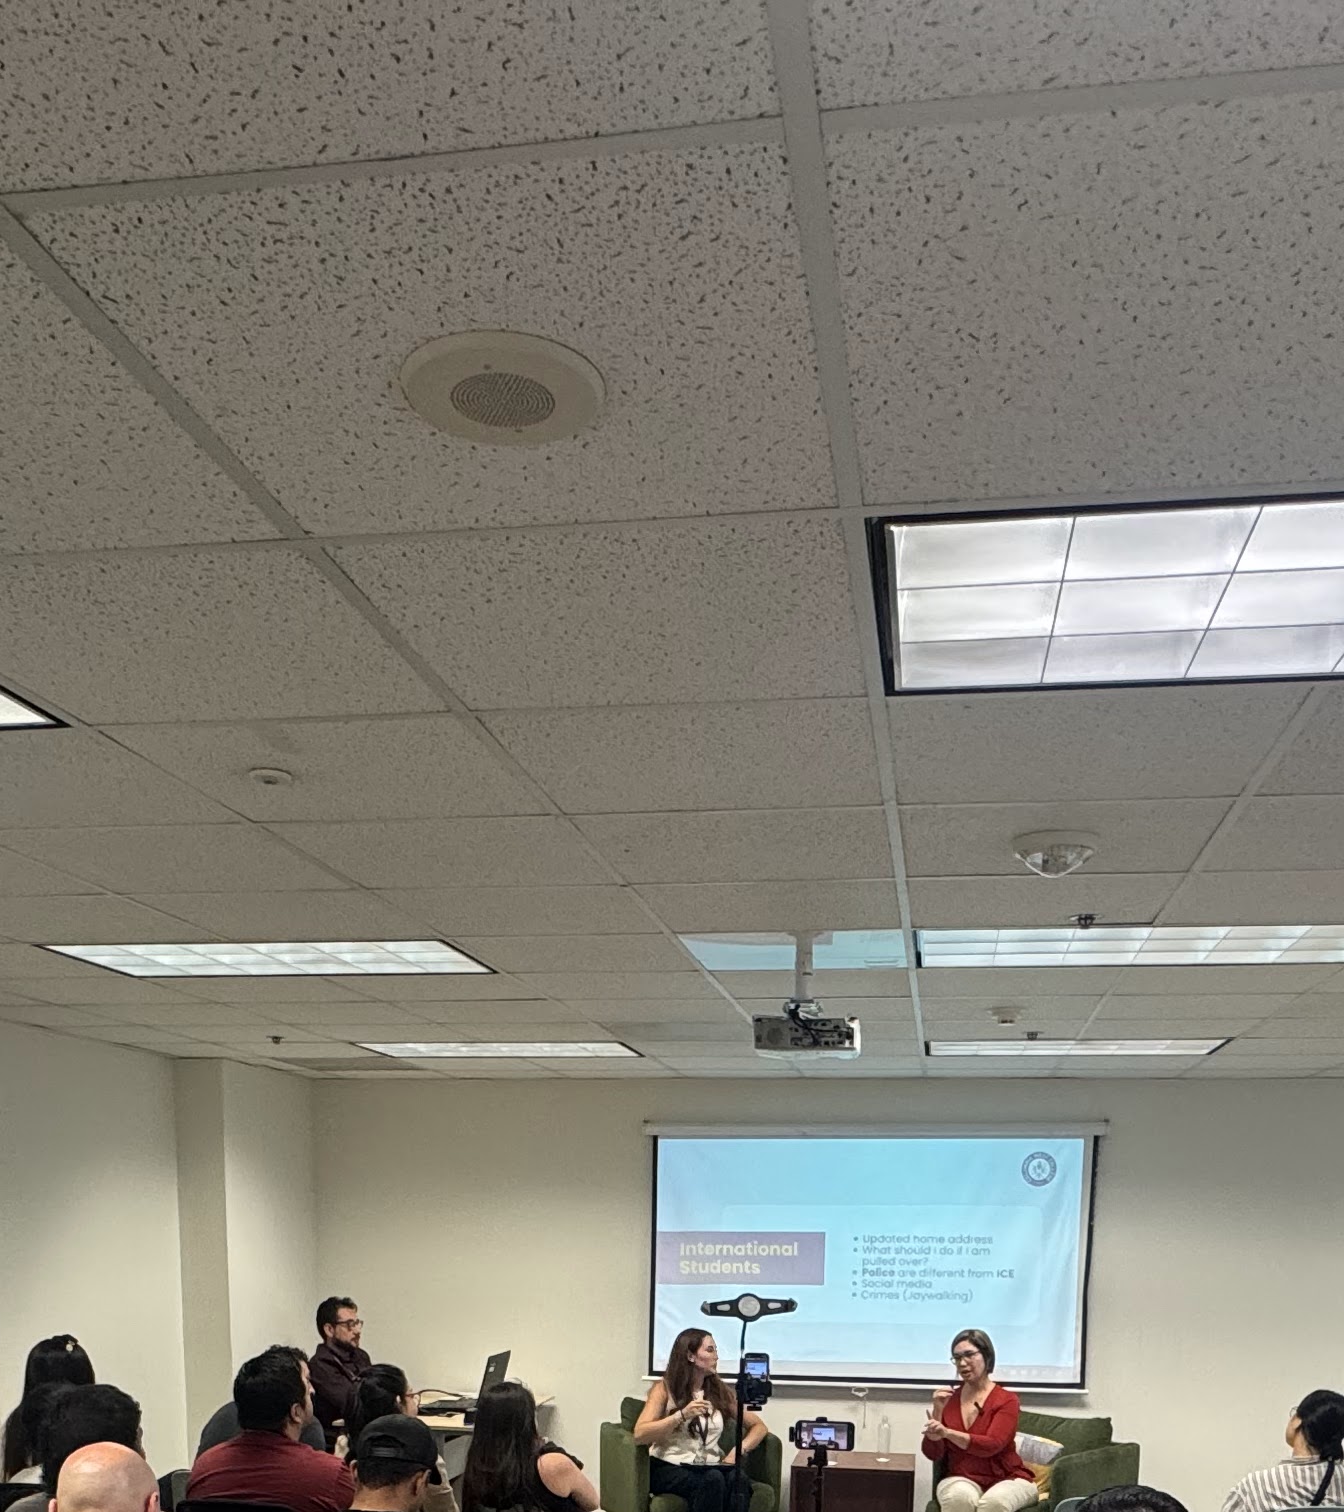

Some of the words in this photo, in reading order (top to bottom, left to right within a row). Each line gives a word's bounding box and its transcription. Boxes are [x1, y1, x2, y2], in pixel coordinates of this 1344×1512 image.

[862, 1234, 910, 1245] Updated
[913, 1234, 945, 1244] home
[947, 1234, 993, 1245] address
[679, 1241, 798, 1257] International
[862, 1245, 892, 1255] What
[894, 1245, 931, 1255] should
[939, 1245, 954, 1255] do
[956, 1245, 963, 1255] if
[971, 1247, 991, 1256] am
[679, 1260, 761, 1275] Students
[862, 1256, 896, 1268] pulled
[898, 1256, 929, 1266] over?
[862, 1267, 895, 1277] Police
[898, 1269, 917, 1278] are
[918, 1268, 965, 1278] different
[967, 1268, 994, 1278] from
[996, 1269, 1015, 1278] ICE
[861, 1279, 893, 1289] Social
[896, 1279, 933, 1289] media
[860, 1290, 900, 1300] Crimes
[902, 1288, 974, 1303] (Jaywalking)
